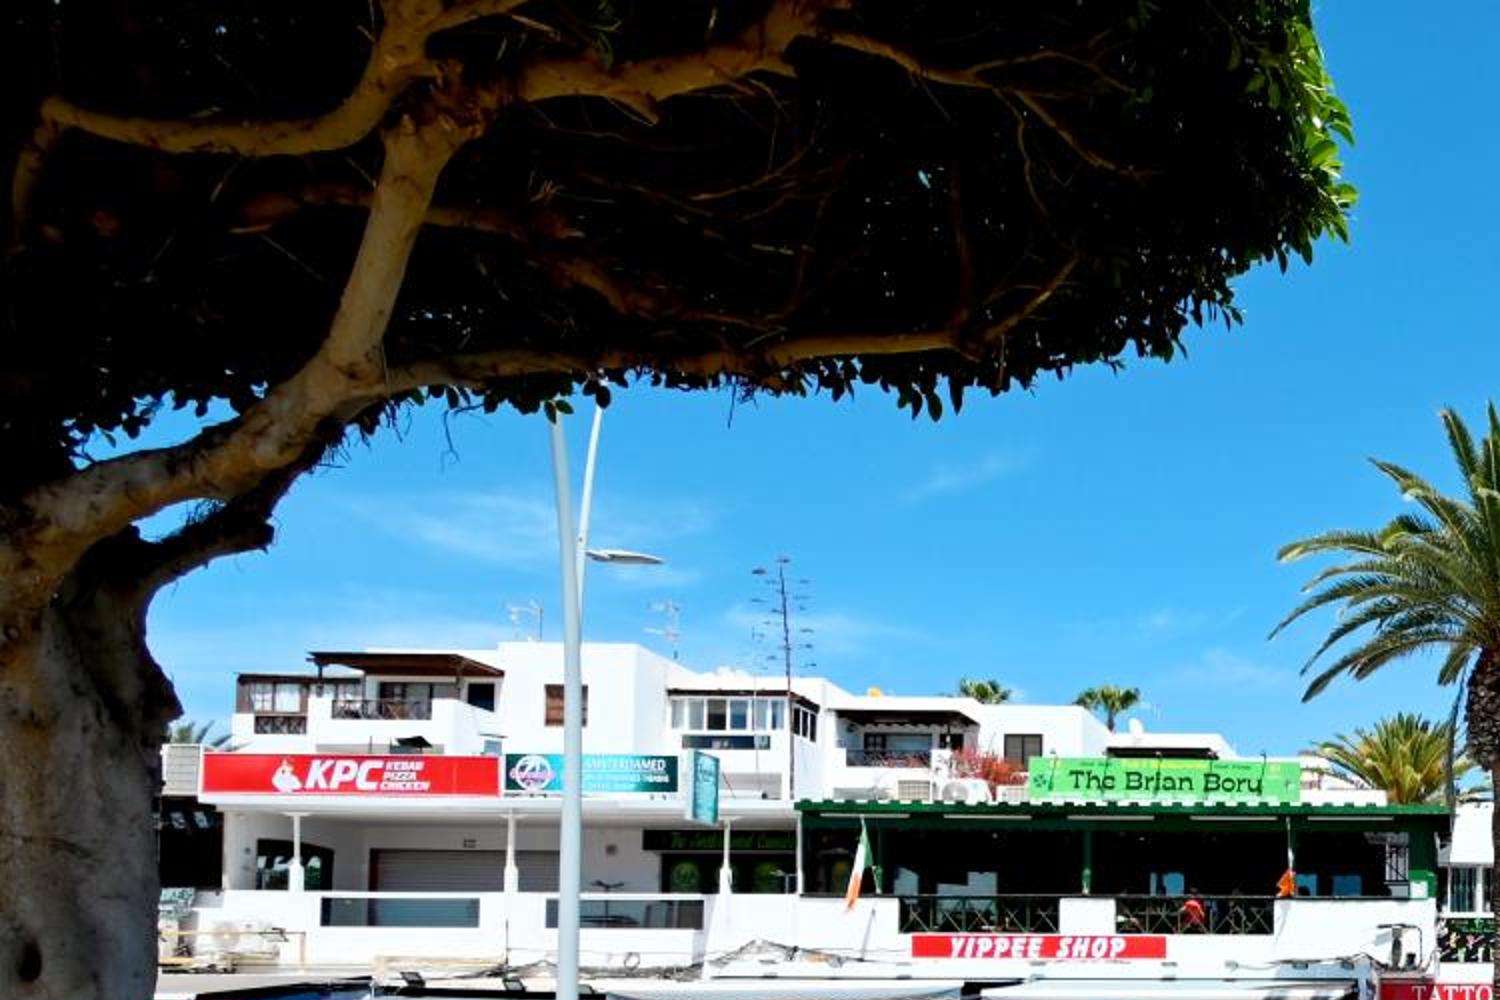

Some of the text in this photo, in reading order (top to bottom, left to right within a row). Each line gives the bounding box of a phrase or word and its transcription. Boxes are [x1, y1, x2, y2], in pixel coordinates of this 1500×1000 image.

[304, 759, 385, 790] KPC
[1069, 770, 1115, 790] The
[1125, 771, 1194, 791] Brian
[951, 937, 1126, 959] YIPPEE SHOP
